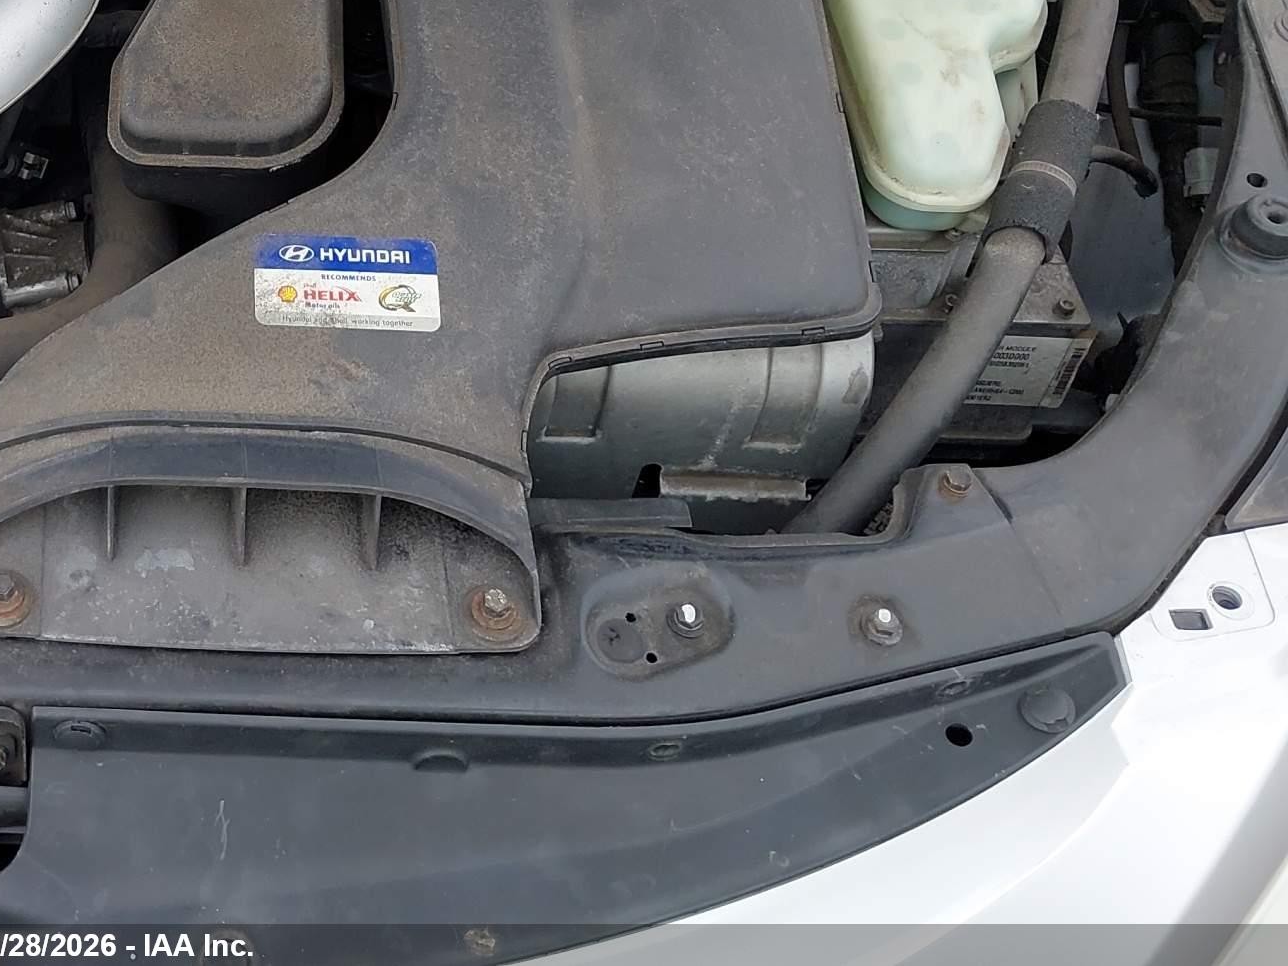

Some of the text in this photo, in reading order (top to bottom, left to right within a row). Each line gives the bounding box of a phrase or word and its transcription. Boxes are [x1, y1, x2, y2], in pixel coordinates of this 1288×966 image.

[319, 247, 411, 264] HYUNDAI
[321, 273, 377, 282] RECOMMENDS
[303, 287, 361, 302] HELIX
[351, 318, 380, 327] working
[382, 319, 414, 328] together
